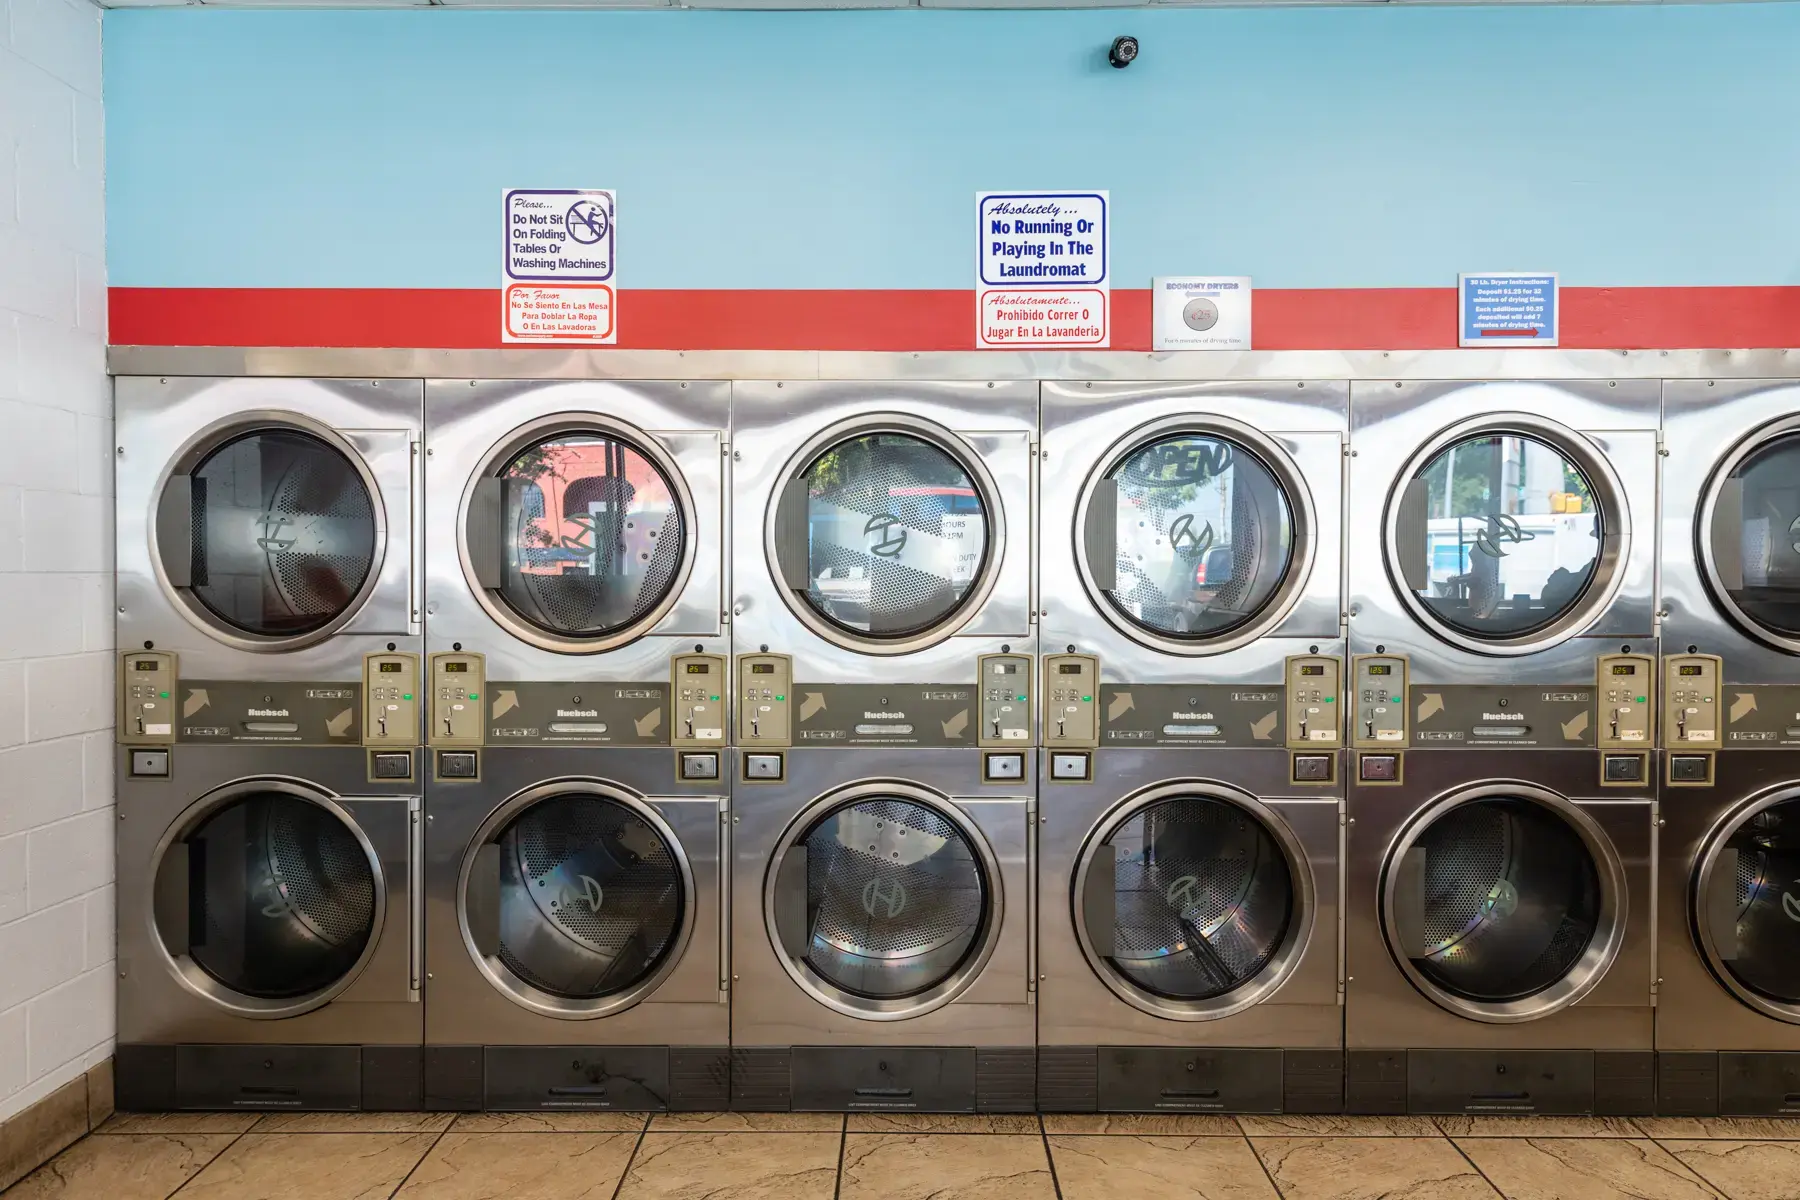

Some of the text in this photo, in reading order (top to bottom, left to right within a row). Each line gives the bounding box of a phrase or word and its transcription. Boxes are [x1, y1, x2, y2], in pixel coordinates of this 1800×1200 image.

[514, 198, 553, 209] Please...
[988, 202, 1061, 216] Absolutely
[513, 214, 564, 225] Do Not Sit
[992, 218, 1094, 237] No Running Or
[513, 228, 566, 242] On Folding
[513, 243, 562, 254] Tables Or
[992, 241, 1094, 259] Playing In The
[513, 258, 607, 270] Washing Machines
[1000, 262, 1086, 277] Laundromat
[513, 290, 560, 300] Por Favor
[578, 313, 598, 322] Ropa
[997, 308, 1089, 321] Prohibido Correr O
[558, 323, 596, 331] Lavadoras
[987, 326, 1014, 340] Jugar
[1017, 326, 1028, 337] En
[1032, 326, 1043, 337] La
[248, 708, 289, 717] Huebsch
